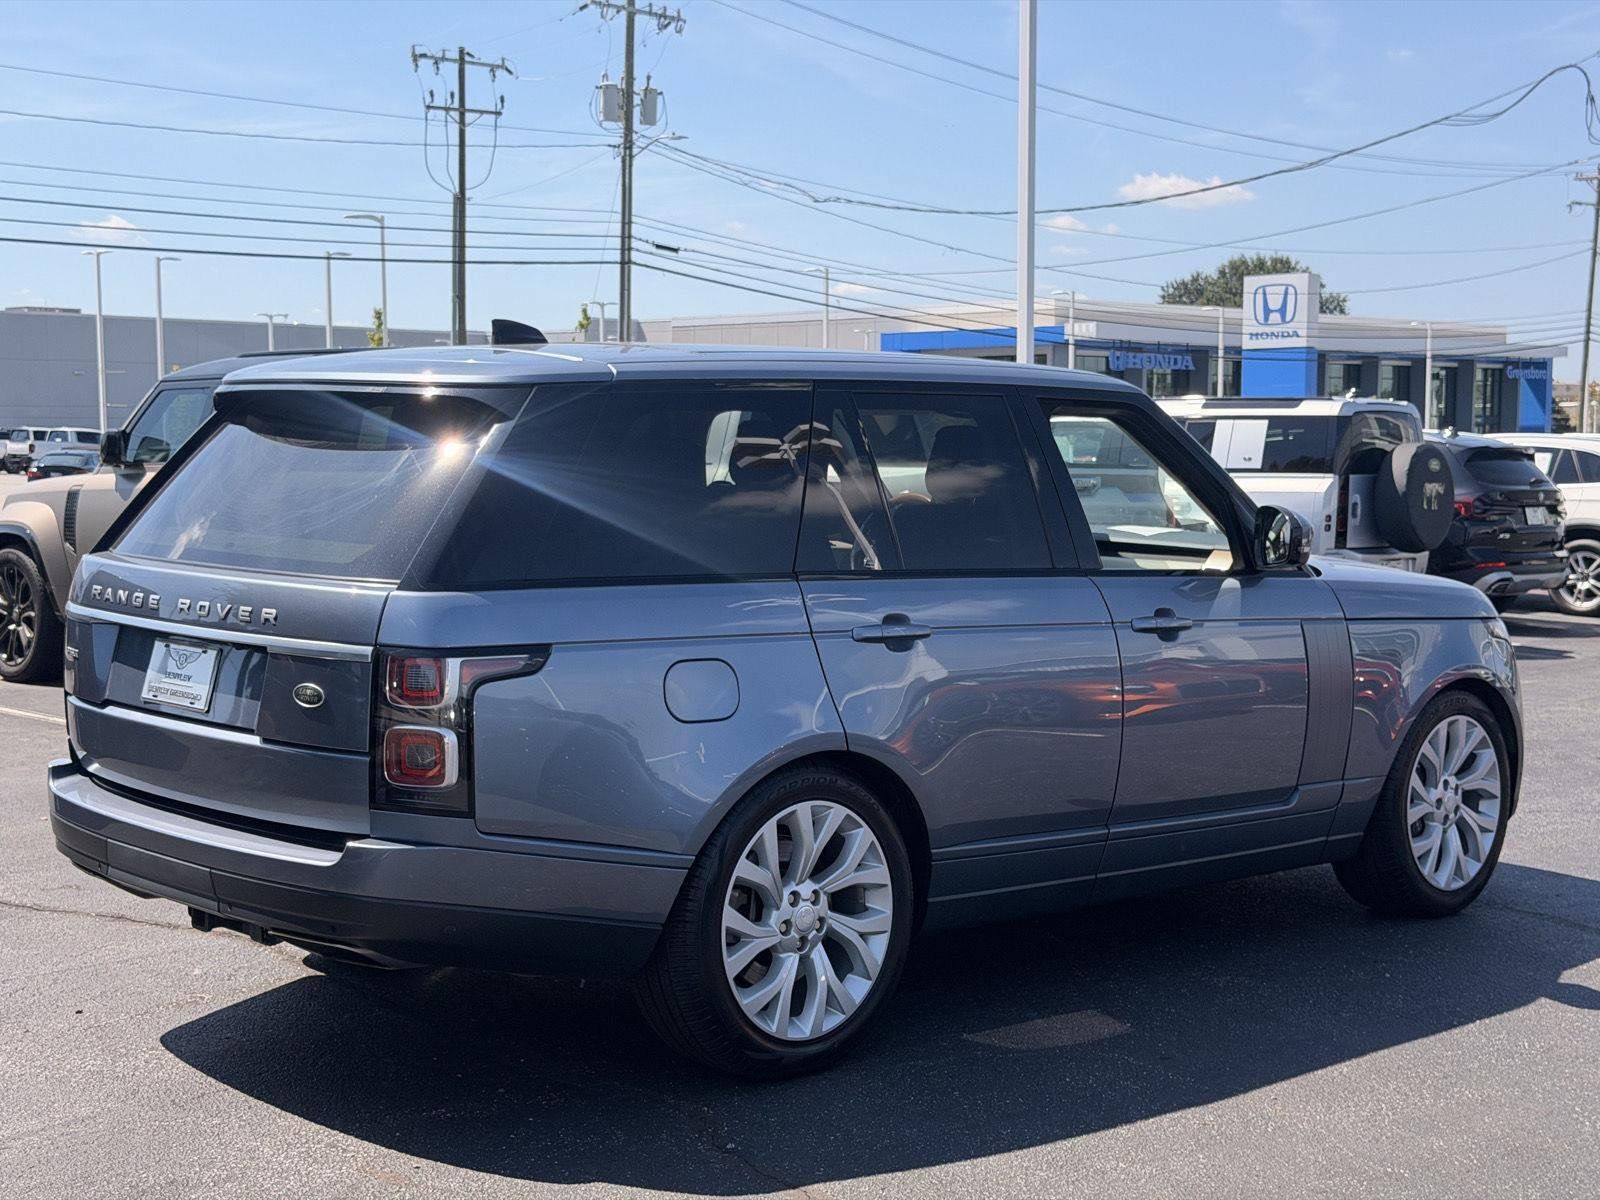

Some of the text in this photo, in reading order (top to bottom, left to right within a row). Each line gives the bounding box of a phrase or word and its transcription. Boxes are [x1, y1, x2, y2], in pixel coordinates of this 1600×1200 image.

[1249, 330, 1300, 340] HONDA
[1126, 351, 1195, 370] HONDA
[91, 584, 278, 626] RANGE ROVER
